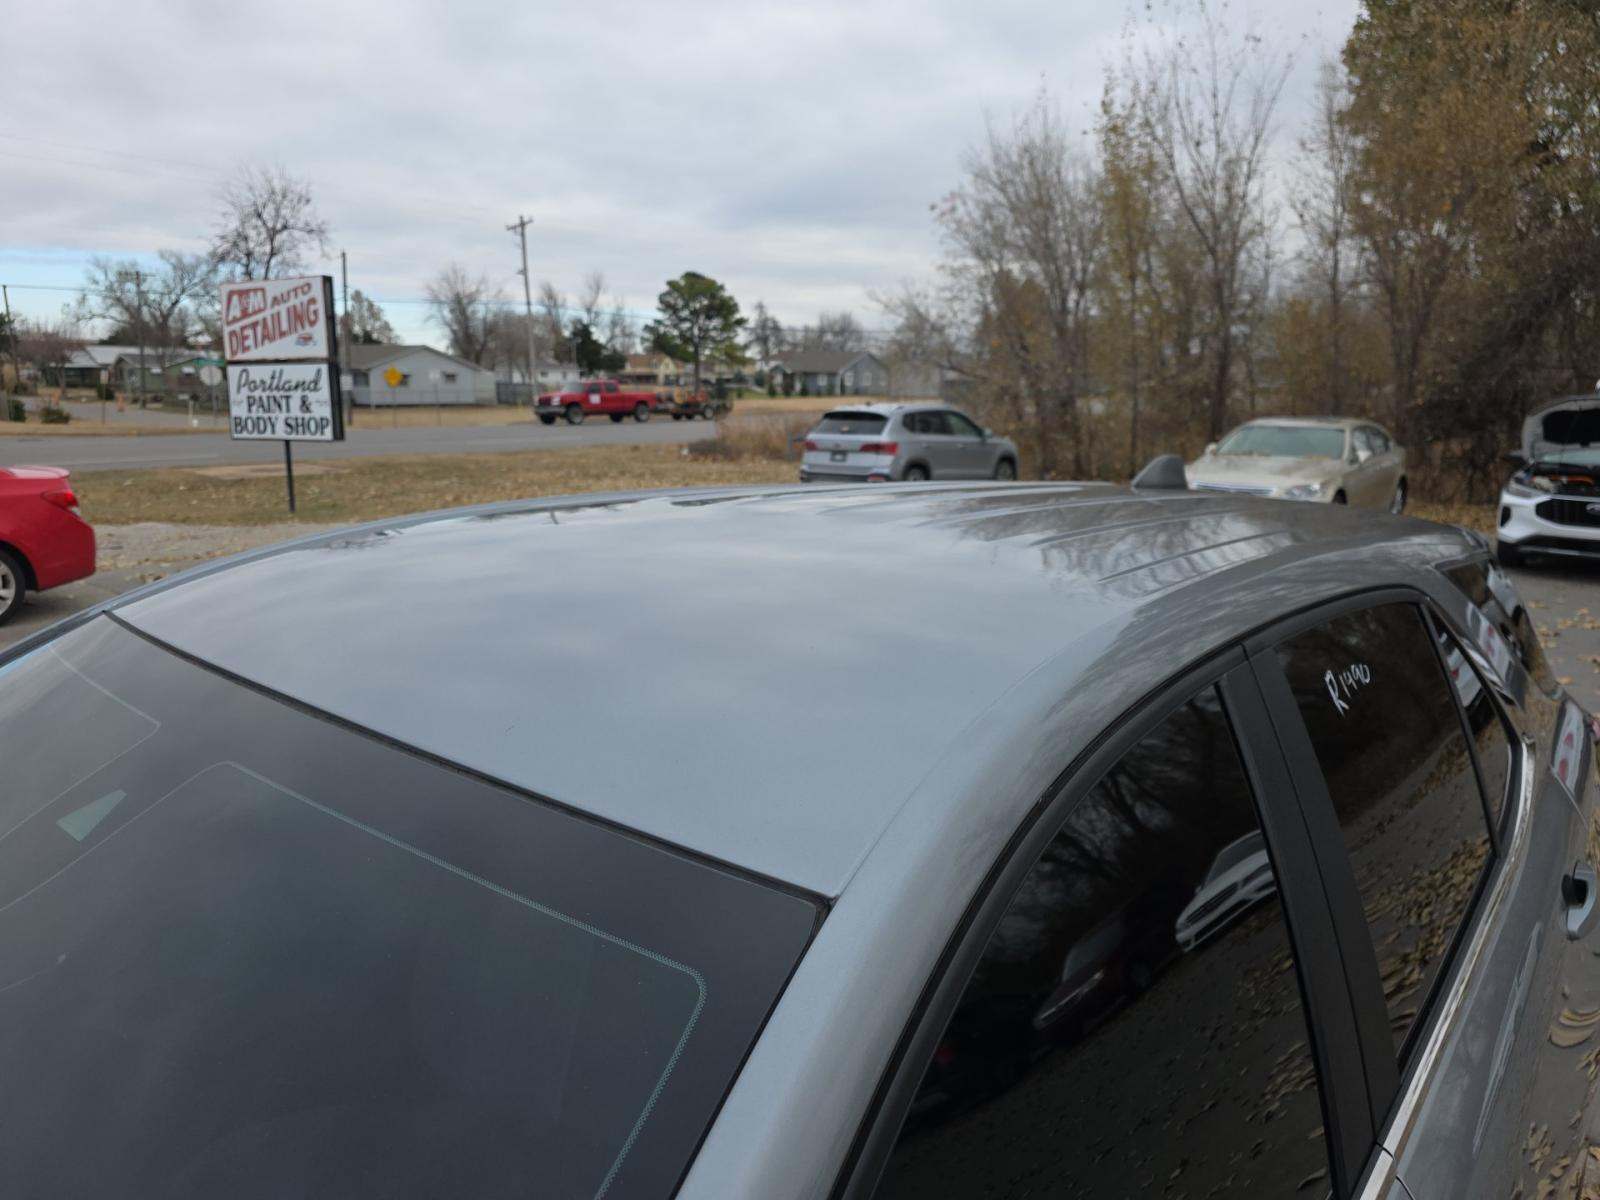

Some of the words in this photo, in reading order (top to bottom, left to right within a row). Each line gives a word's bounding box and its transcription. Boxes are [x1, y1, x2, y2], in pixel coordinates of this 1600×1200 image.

[271, 283, 312, 307] AUTO
[229, 297, 319, 356] DETAILING
[236, 368, 323, 394] Portland
[246, 395, 292, 414] PAINT
[299, 395, 313, 414] &
[233, 417, 280, 434] BODY
[284, 417, 330, 436] SHOP
